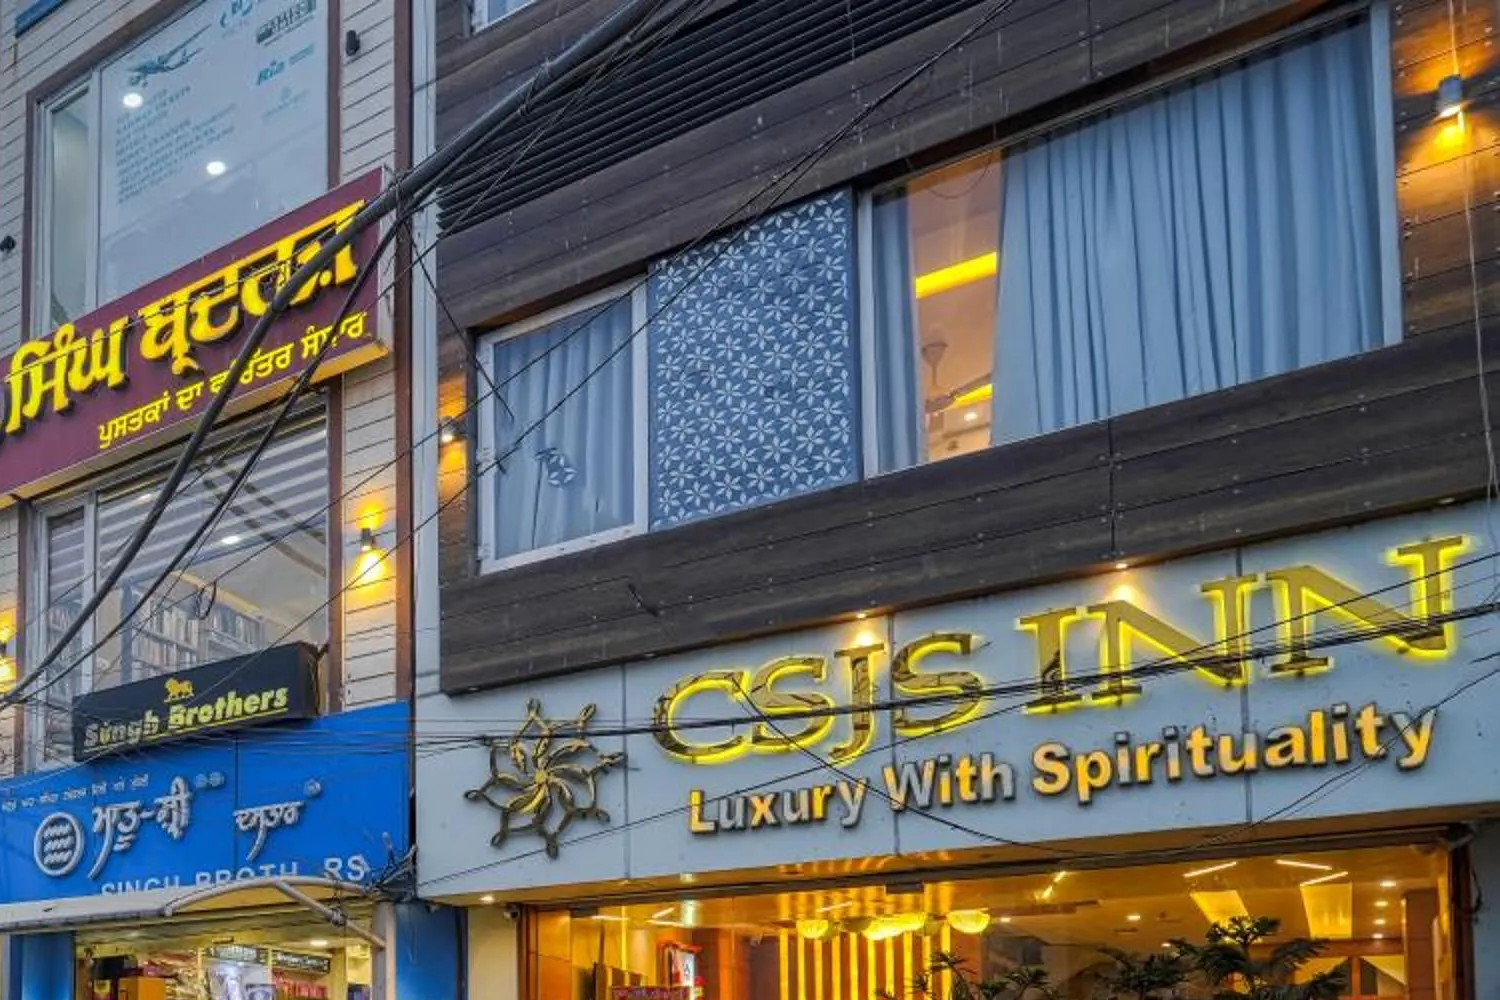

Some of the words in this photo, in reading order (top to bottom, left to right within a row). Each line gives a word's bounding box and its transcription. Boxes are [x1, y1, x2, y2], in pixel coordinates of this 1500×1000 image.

[5, 316, 129, 435] ਸਿੰਘ
[176, 380, 204, 411] ਦਾ
[651, 630, 987, 766] CSJS
[1017, 533, 1471, 715] INN
[84, 709, 159, 748] Singh
[167, 687, 289, 732] Brothers
[689, 776, 869, 835] Luxury
[884, 752, 1016, 811] With
[1033, 702, 1438, 803] Spirituality
